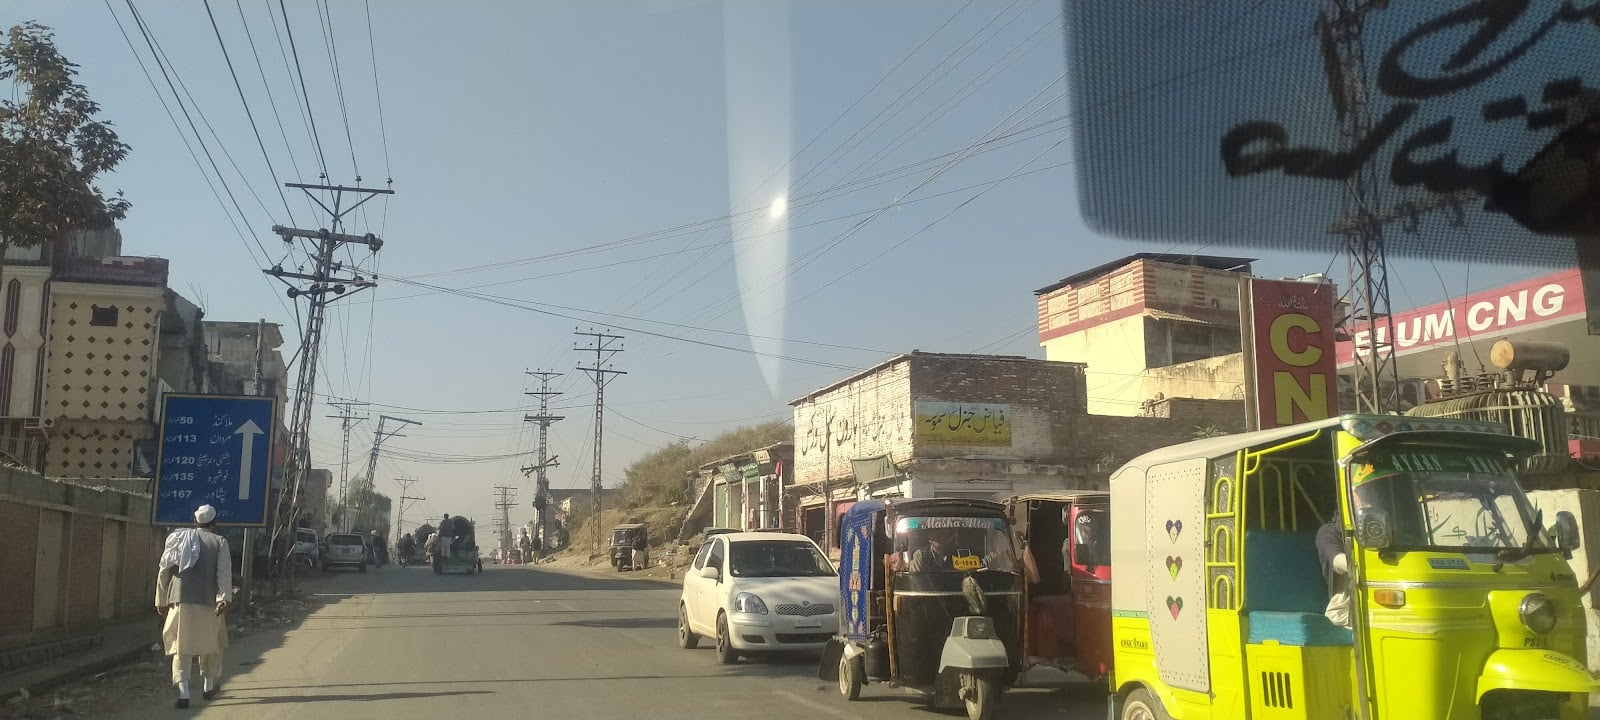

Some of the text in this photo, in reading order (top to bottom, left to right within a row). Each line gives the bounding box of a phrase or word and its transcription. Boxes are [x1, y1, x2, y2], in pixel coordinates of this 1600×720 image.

[1352, 284, 1566, 357] ELUM CNG
[179, 416, 194, 425] 50
[948, 405, 975, 432] جنرل
[973, 407, 1005, 434] فیاض
[177, 434, 197, 443] 113
[209, 434, 232, 445] مردان
[175, 456, 195, 465] 120
[174, 472, 194, 481] 135
[171, 490, 193, 499] 167
[204, 487, 227, 503] پشاور
[921, 516, 960, 529] Masha
